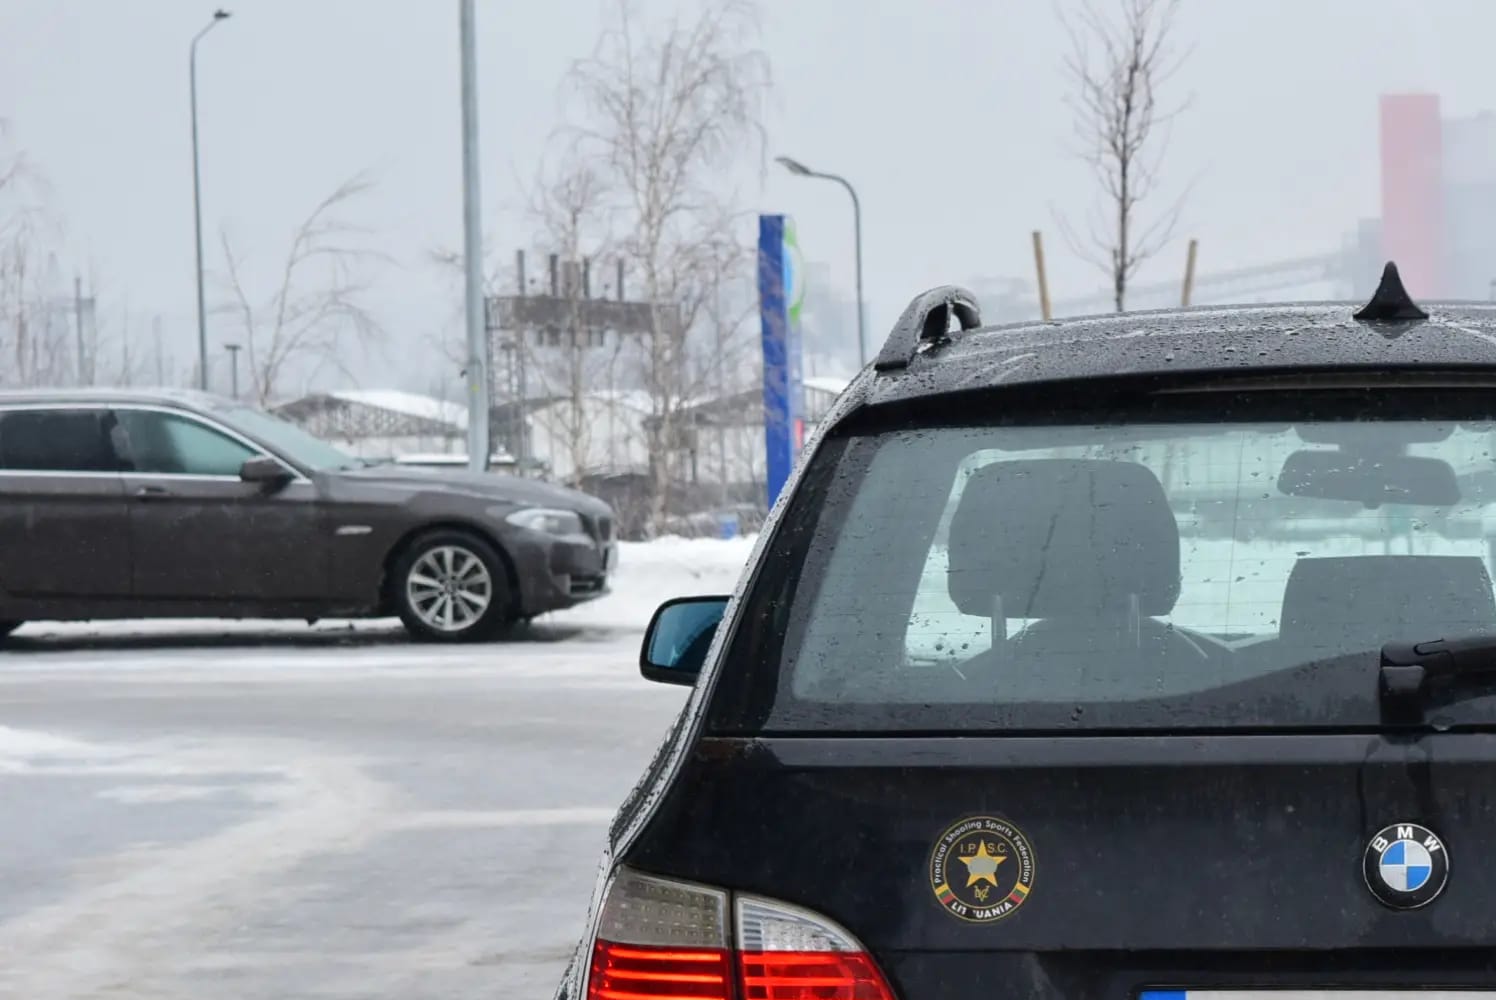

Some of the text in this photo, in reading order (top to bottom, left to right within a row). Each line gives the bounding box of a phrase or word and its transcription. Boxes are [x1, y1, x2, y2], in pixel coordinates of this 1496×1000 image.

[934, 820, 1031, 884] Practical Shooting Sports Federation
[1371, 826, 1441, 853] BMW
[951, 901, 1013, 919] LITUANIA
